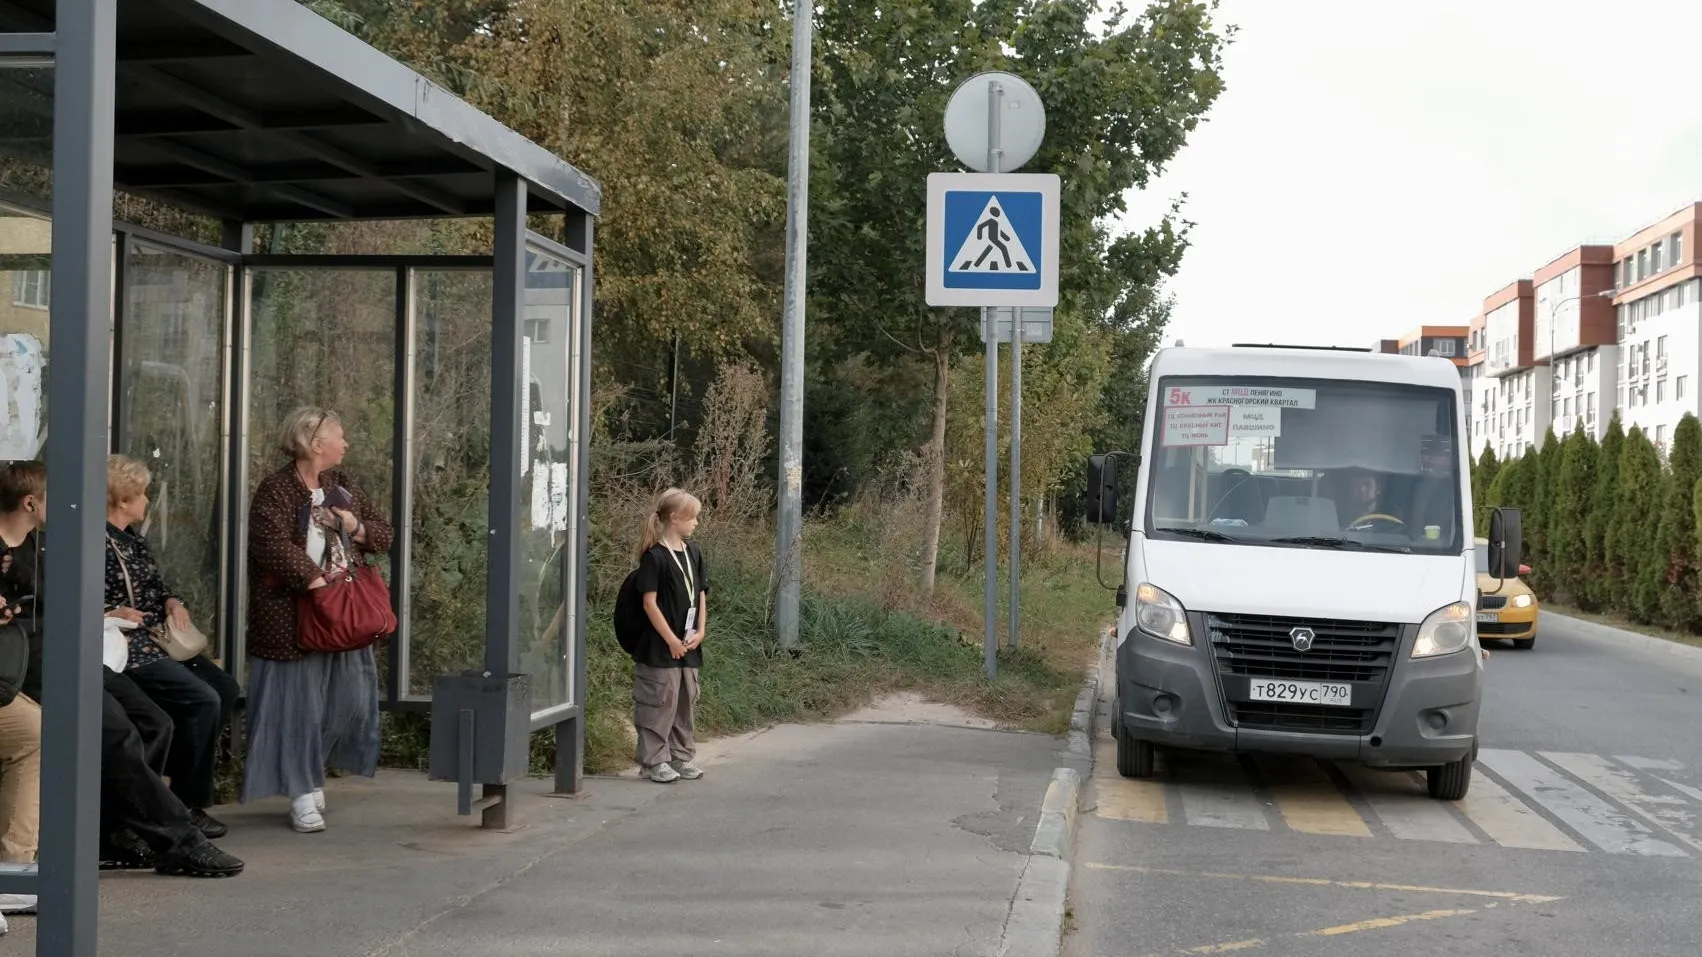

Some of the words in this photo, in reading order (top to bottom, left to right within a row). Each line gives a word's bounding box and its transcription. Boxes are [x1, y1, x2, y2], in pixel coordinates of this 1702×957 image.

[1231, 388, 1249, 397] МЦД
[1250, 389, 1283, 397] ПЕНЯГИНО
[1218, 397, 1269, 406] КРАСНОГОРСКИЙ
[1270, 399, 1298, 407] КВАРТАЛ
[1243, 413, 1264, 421] МЦД
[1322, 685, 1347, 698] 790
